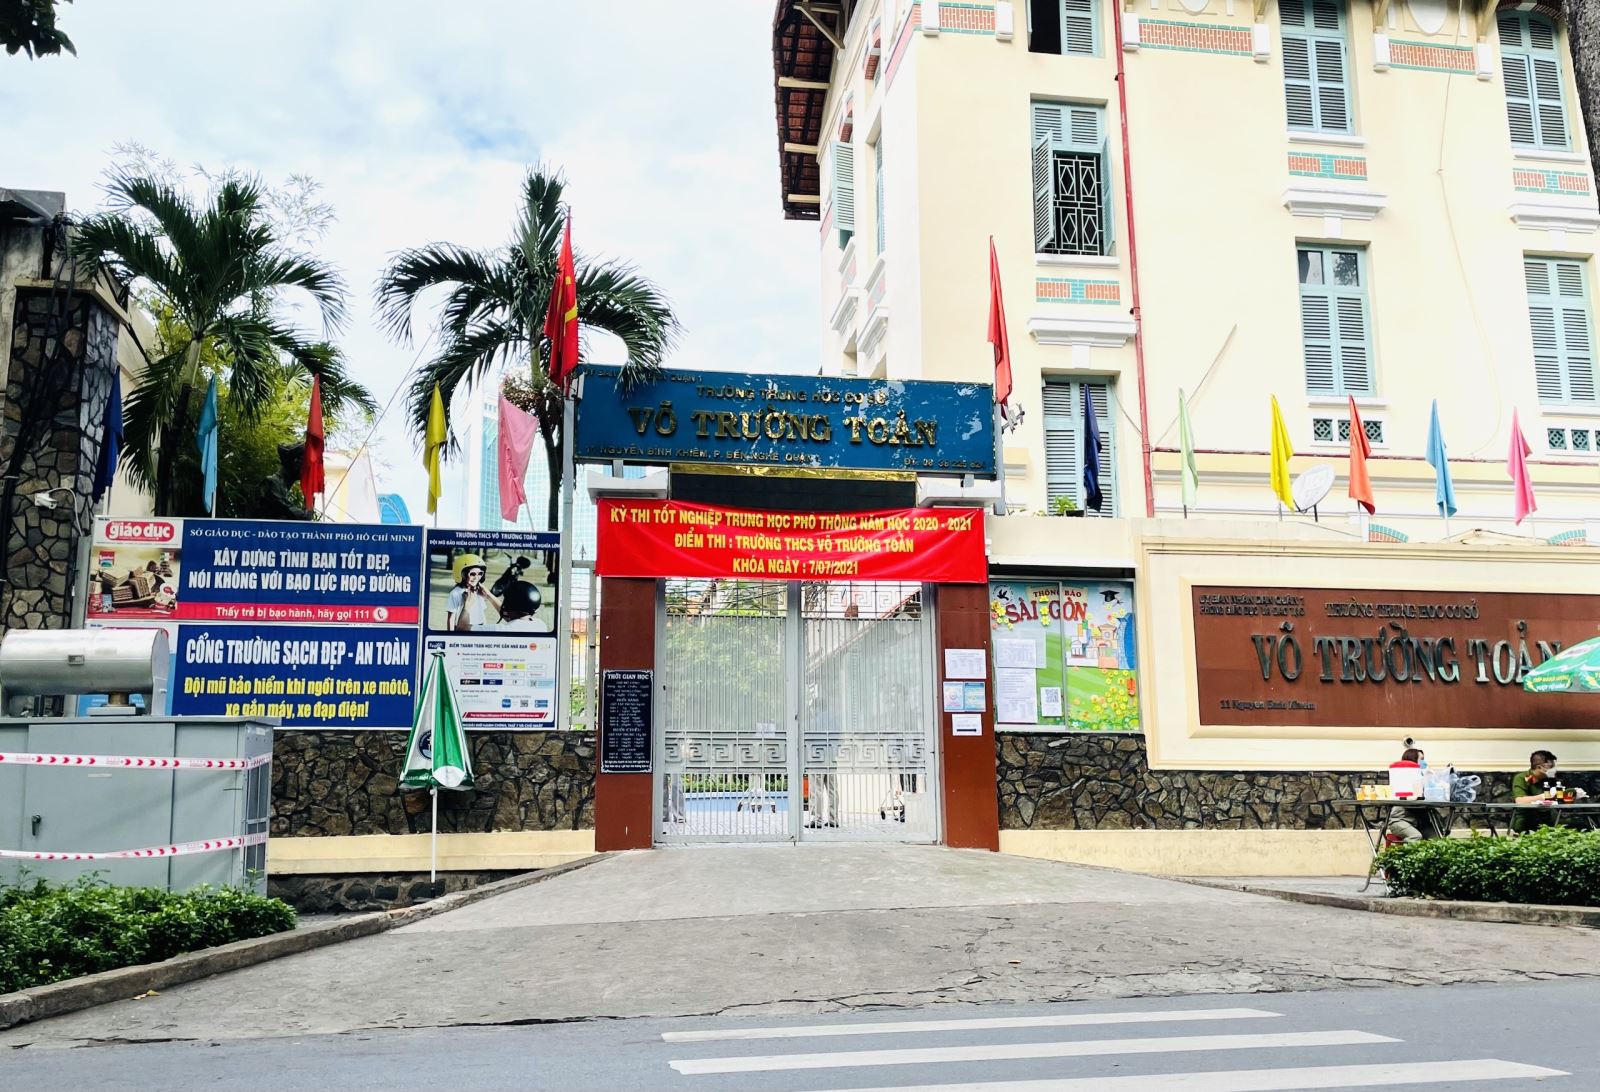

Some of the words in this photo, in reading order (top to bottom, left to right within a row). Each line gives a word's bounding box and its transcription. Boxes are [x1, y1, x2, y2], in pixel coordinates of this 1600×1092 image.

[696, 384, 755, 401] TRƯỜNG
[627, 399, 677, 436] VÕ
[690, 404, 832, 442] TRƯỜNG
[843, 408, 937, 446] TOẢN
[611, 505, 626, 523] KỲ
[631, 509, 650, 523] THI
[654, 503, 676, 524] TỐT
[679, 508, 722, 529] NGHIỆP
[727, 513, 763, 528] TRUNG
[767, 516, 790, 532] HỌC
[820, 514, 857, 530] THÔNG
[860, 514, 884, 531] NĂM
[887, 518, 910, 533] HỌC
[913, 517, 938, 531] 2020
[948, 517, 972, 531] 2021
[109, 522, 142, 539] giáo
[143, 523, 171, 540] dục
[190, 527, 204, 537] SỞ
[204, 527, 229, 538] GIÁO
[231, 529, 251, 539] DỤC
[280, 531, 299, 541] TẠO
[302, 531, 333, 540] THÀNH
[372, 533, 389, 542] CHÍ
[390, 534, 415, 543] MINH
[674, 527, 704, 548] ĐIỂM
[707, 533, 726, 549] THI
[735, 533, 782, 551] TRƯỜNG
[785, 537, 814, 551] THCS
[816, 535, 833, 552] VÕ
[835, 536, 881, 553] TRƯỜNG
[884, 531, 914, 553] TOẢN
[213, 547, 239, 567] XÂY
[241, 548, 276, 570] DỰNG
[280, 549, 309, 568] TÌNH
[312, 552, 337, 571] BẠN
[340, 548, 364, 570] TỐT
[366, 553, 390, 573] ĐẸP,
[733, 554, 765, 573] KHÓA
[768, 555, 799, 574] NGÀY
[809, 560, 858, 575] 7/07/2021
[188, 569, 211, 589] NÓI
[214, 569, 258, 590] KHÔNG
[261, 570, 283, 590] VỚI
[286, 573, 311, 594] BẠO
[314, 572, 337, 594] LỰC
[340, 574, 366, 595] HỌC
[369, 573, 412, 593] ĐƯỜNG
[1064, 589, 1082, 598] BÁO
[216, 606, 240, 618] Thấy
[242, 607, 255, 617] trẻ
[257, 607, 266, 618] bị
[269, 608, 286, 619] bạo
[289, 608, 315, 619] hành,
[318, 608, 334, 620] hãy
[337, 609, 352, 621] gọi
[355, 610, 369, 619] 111
[1005, 597, 1038, 624] SÀI
[1048, 596, 1088, 622] GÒN
[1324, 596, 1374, 619] TRƯỜNG
[185, 632, 224, 664] CỔNG
[227, 635, 281, 665] TRƯỜNG
[282, 639, 318, 670] SẠCH
[321, 640, 346, 670] ĐẸP
[355, 641, 374, 665] AN
[375, 637, 410, 666] TOÀN
[1312, 620, 1460, 682] TRƯỜNG
[184, 676, 205, 697] Đội
[206, 677, 226, 694] mũ
[229, 675, 252, 695] bảo
[254, 674, 285, 695] hiểm
[286, 677, 306, 695] khi
[308, 676, 335, 697] ngồi
[336, 677, 361, 695] trên
[362, 680, 376, 695] xe
[378, 677, 412, 697] môtô,
[225, 702, 240, 716] xe
[267, 699, 295, 719] máy,
[297, 703, 311, 717] xe
[314, 700, 337, 721] đạp
[338, 699, 370, 720] điện!
